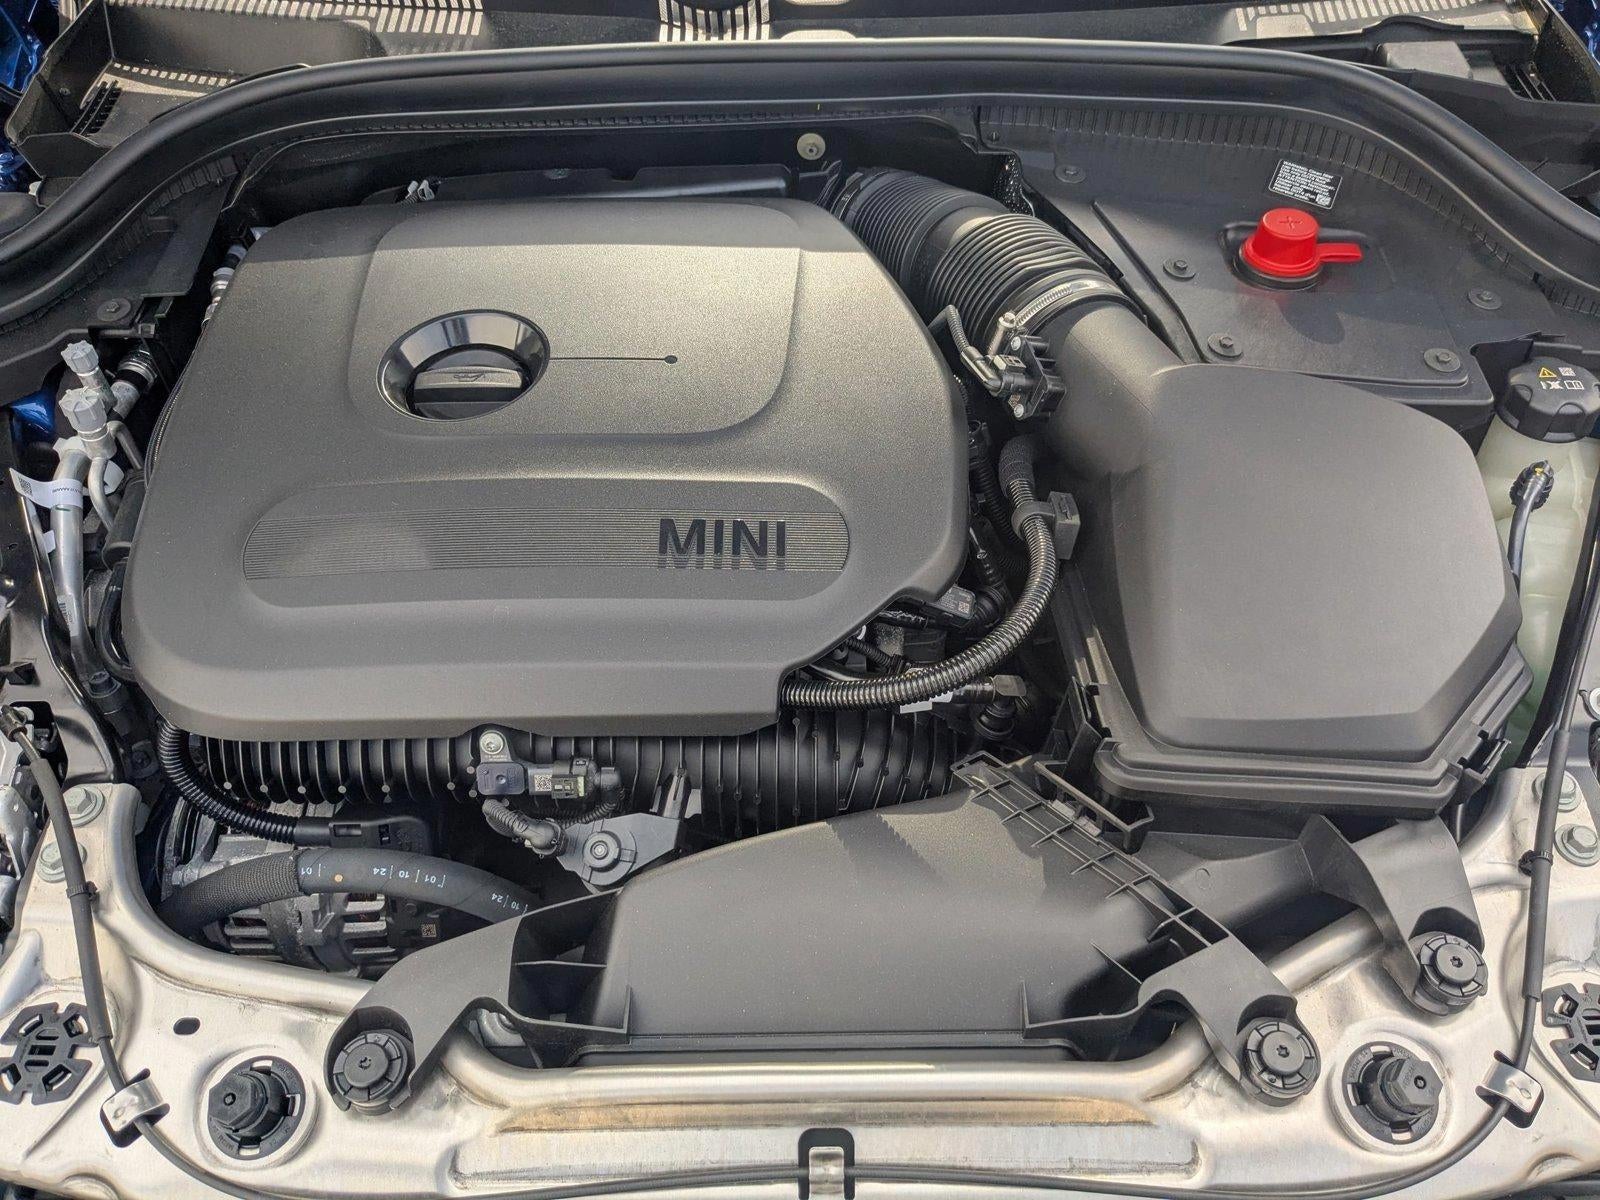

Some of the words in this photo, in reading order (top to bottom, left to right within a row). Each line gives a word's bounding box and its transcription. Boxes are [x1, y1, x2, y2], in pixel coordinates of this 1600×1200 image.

[658, 518, 786, 570] MINI
[372, 866, 387, 876] 24
[491, 892, 504, 903] 24
